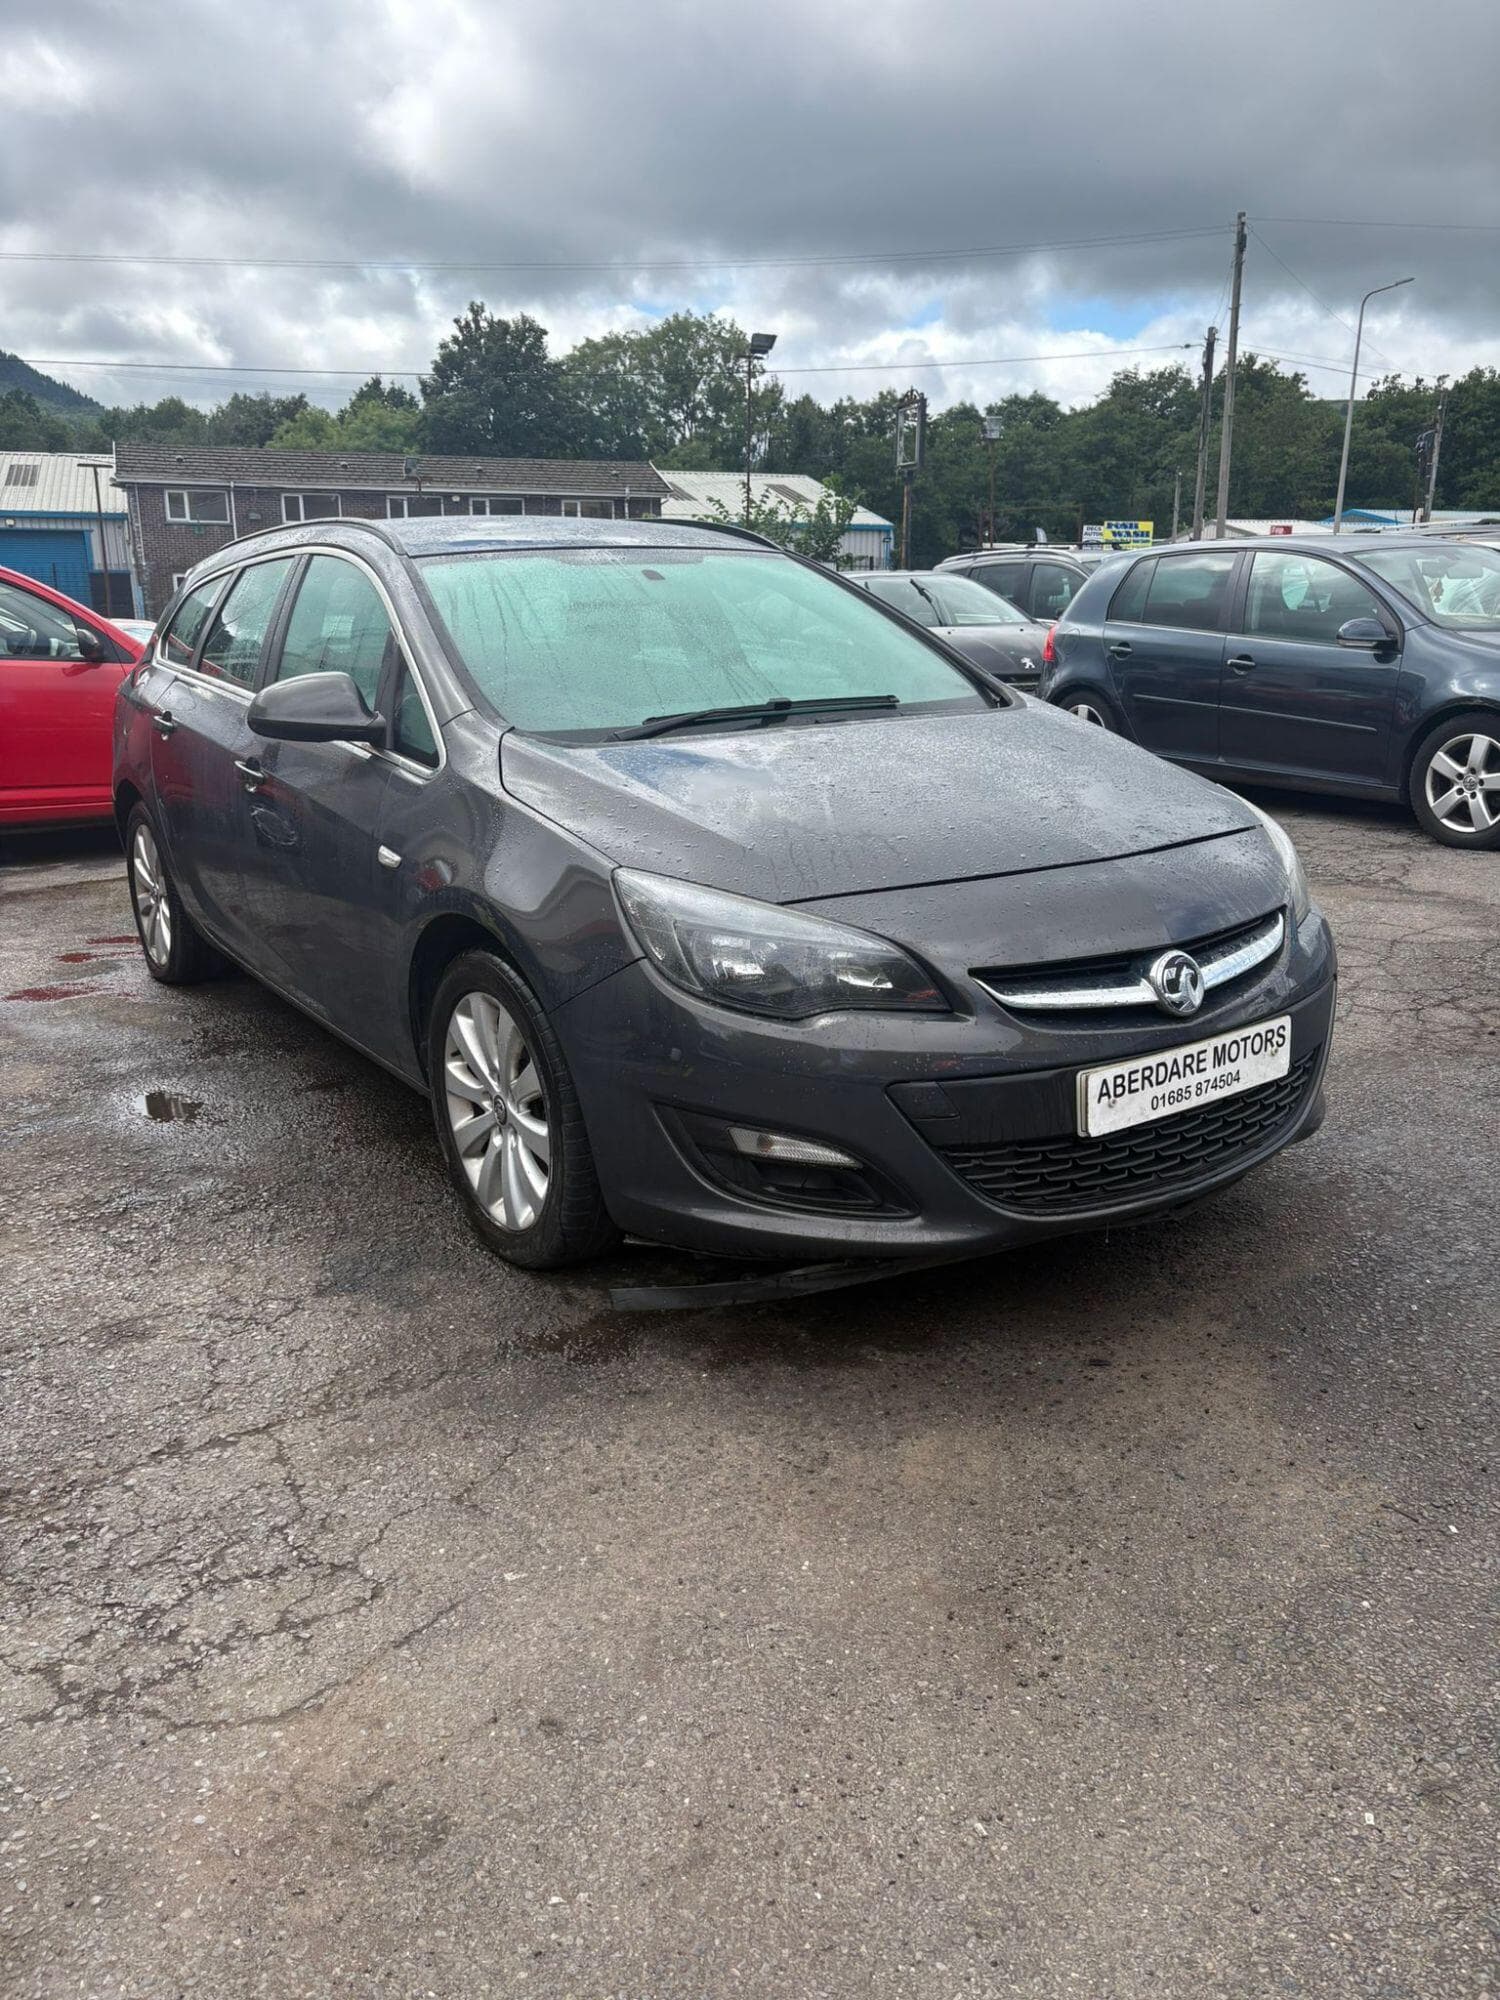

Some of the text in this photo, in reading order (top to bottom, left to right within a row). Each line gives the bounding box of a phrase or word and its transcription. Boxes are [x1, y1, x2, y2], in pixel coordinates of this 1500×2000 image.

[1097, 1024, 1286, 1104] ABERDARE MOTORS
[1151, 1069, 1241, 1110] 01685 874504
